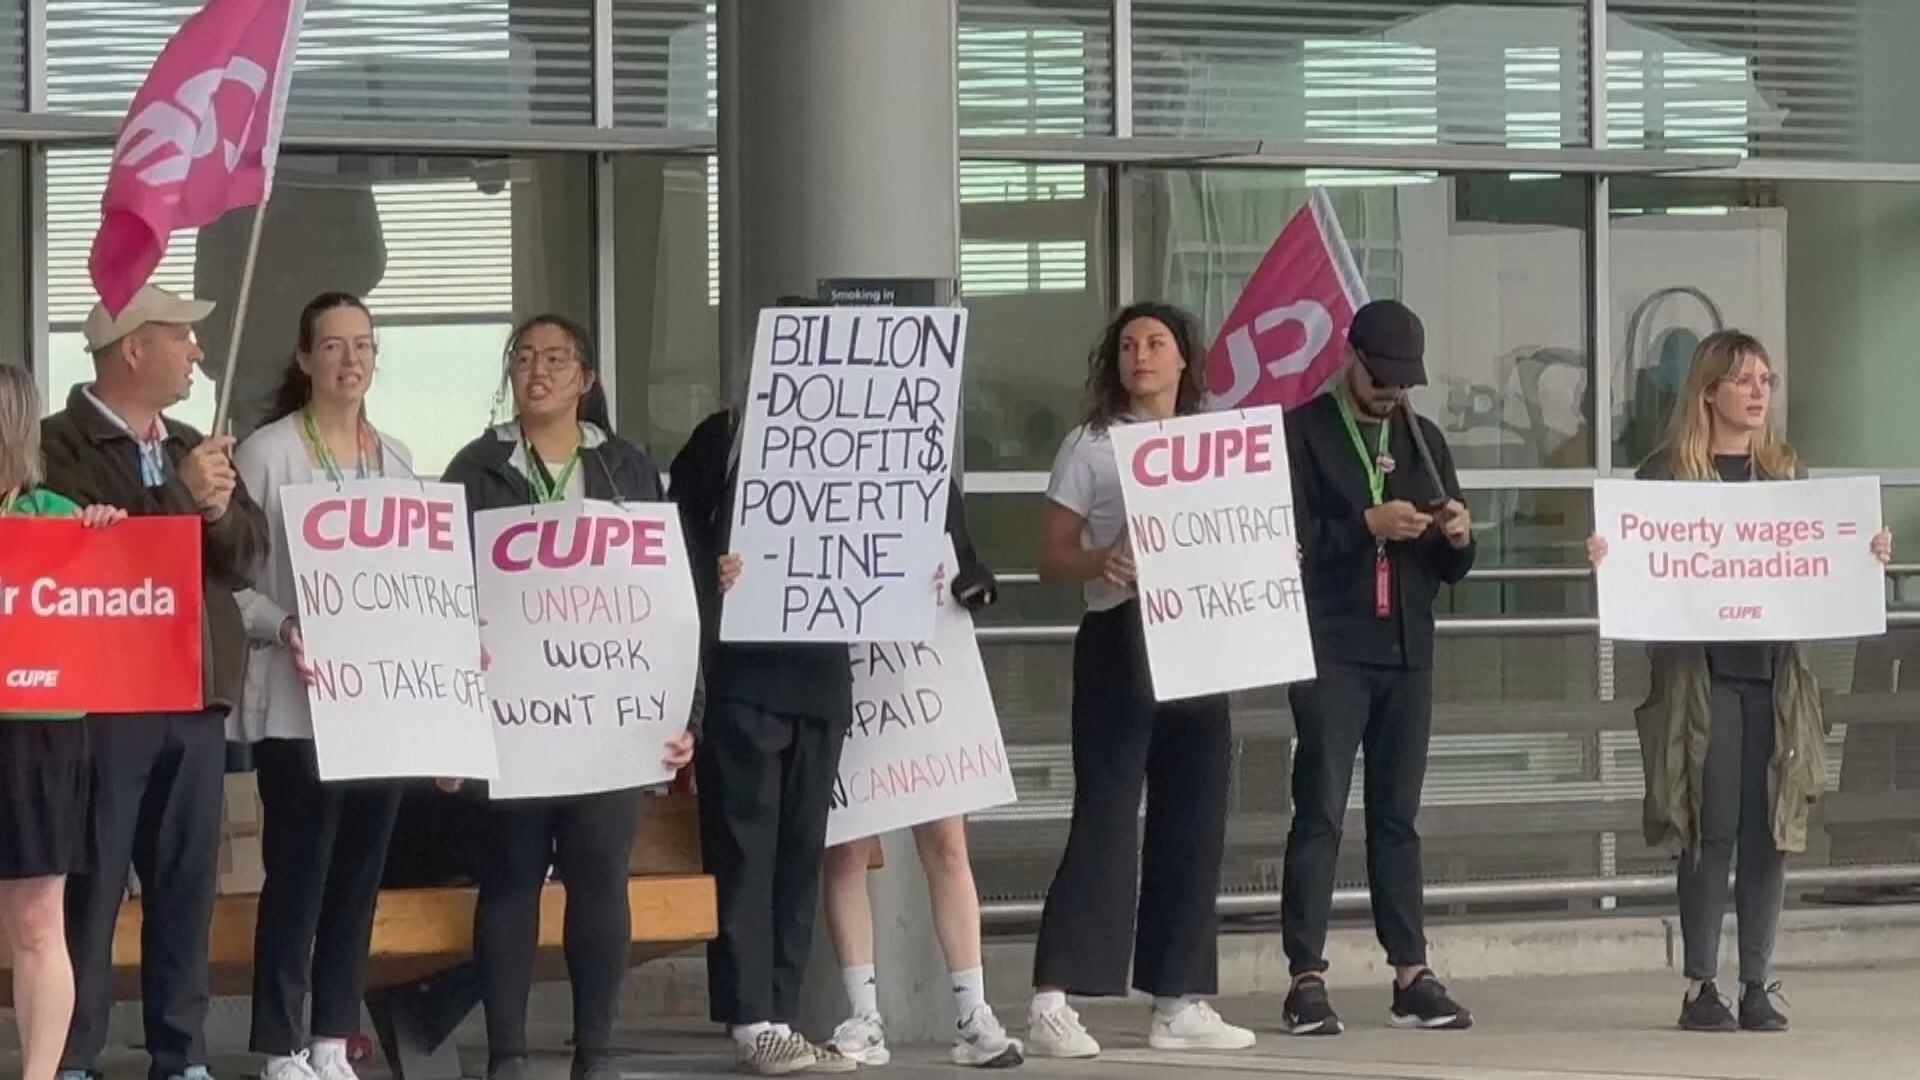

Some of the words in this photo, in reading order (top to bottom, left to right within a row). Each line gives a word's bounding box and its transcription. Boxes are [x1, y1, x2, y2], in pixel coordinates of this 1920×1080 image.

[831, 288, 880, 301] Smoking
[770, 313, 961, 368] BILLION
[757, 372, 945, 423] -DOLLAR
[1132, 424, 1272, 487] CUPE
[302, 497, 454, 551] CUPE
[740, 478, 945, 526] POVERTY
[491, 516, 666, 572] CUPE
[1131, 513, 1166, 555] NO
[1171, 504, 1291, 547] CONTRACT
[1620, 513, 1724, 548] Poverty
[1735, 520, 1825, 546] wages
[763, 533, 905, 579] -LINE
[1649, 551, 1828, 578] UnCanadian
[32, 577, 175, 616] Canada
[300, 570, 343, 616] NO
[352, 571, 476, 625] CONTRACT
[521, 585, 652, 624] UNPAID
[782, 585, 884, 635] PAY
[1145, 588, 1183, 625] NO
[1187, 577, 1301, 620] TAKE-OFF
[1719, 606, 1763, 619] CUPE
[6, 669, 59, 687] CUPE
[543, 638, 650, 671] WORK
[313, 658, 362, 701] NO
[368, 659, 447, 699] TAKE
[492, 693, 594, 726] WON'T
[617, 690, 666, 727] FLY
[845, 688, 943, 739] PAID
